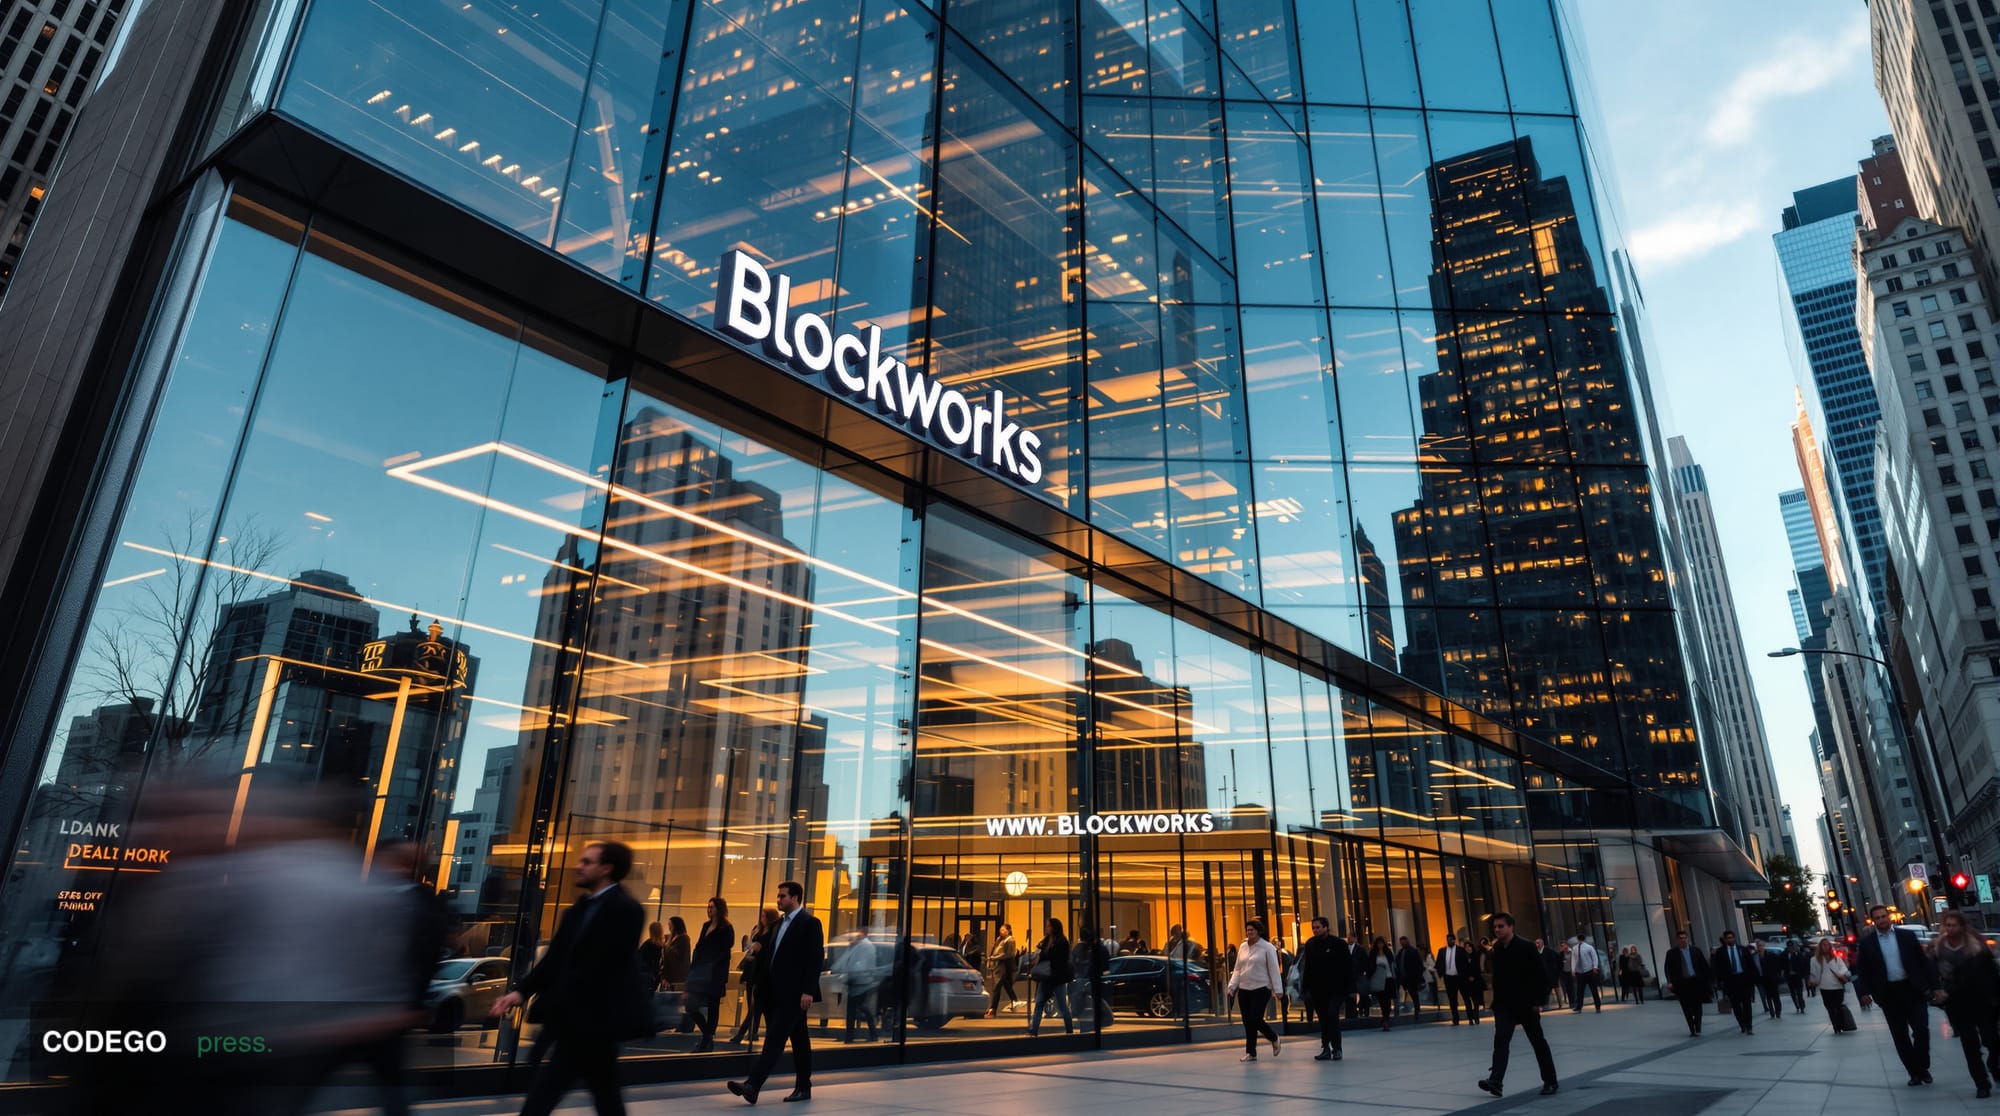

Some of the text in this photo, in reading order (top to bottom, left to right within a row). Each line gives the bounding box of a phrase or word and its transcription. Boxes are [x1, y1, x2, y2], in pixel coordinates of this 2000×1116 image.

[722, 249, 1043, 485] Blockworks
[60, 820, 120, 838] LDANK
[124, 848, 170, 863] HORK
